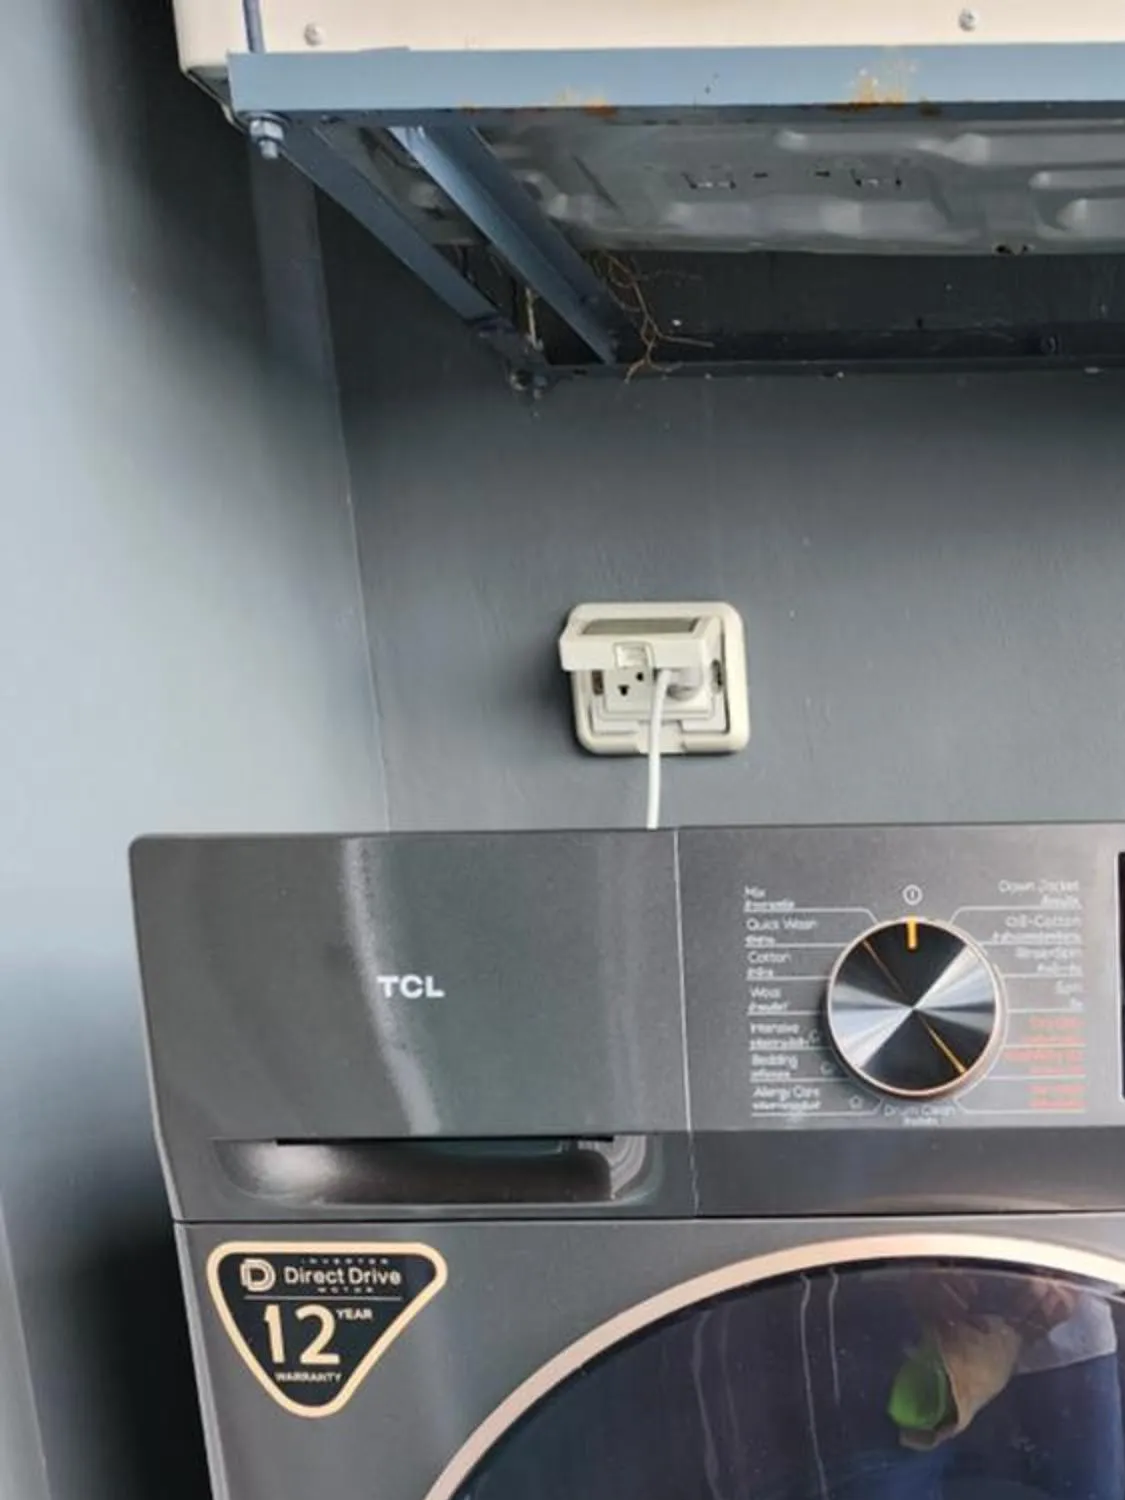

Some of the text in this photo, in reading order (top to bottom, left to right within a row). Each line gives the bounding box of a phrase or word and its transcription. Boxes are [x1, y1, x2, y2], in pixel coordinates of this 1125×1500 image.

[748, 951, 791, 963] Cotton
[377, 974, 444, 999] TCL
[283, 1265, 345, 1285] Direct
[349, 1265, 402, 1286] Drive
[264, 1304, 373, 1365] 12 YEAR
[275, 1371, 342, 1383] WARRANTY
